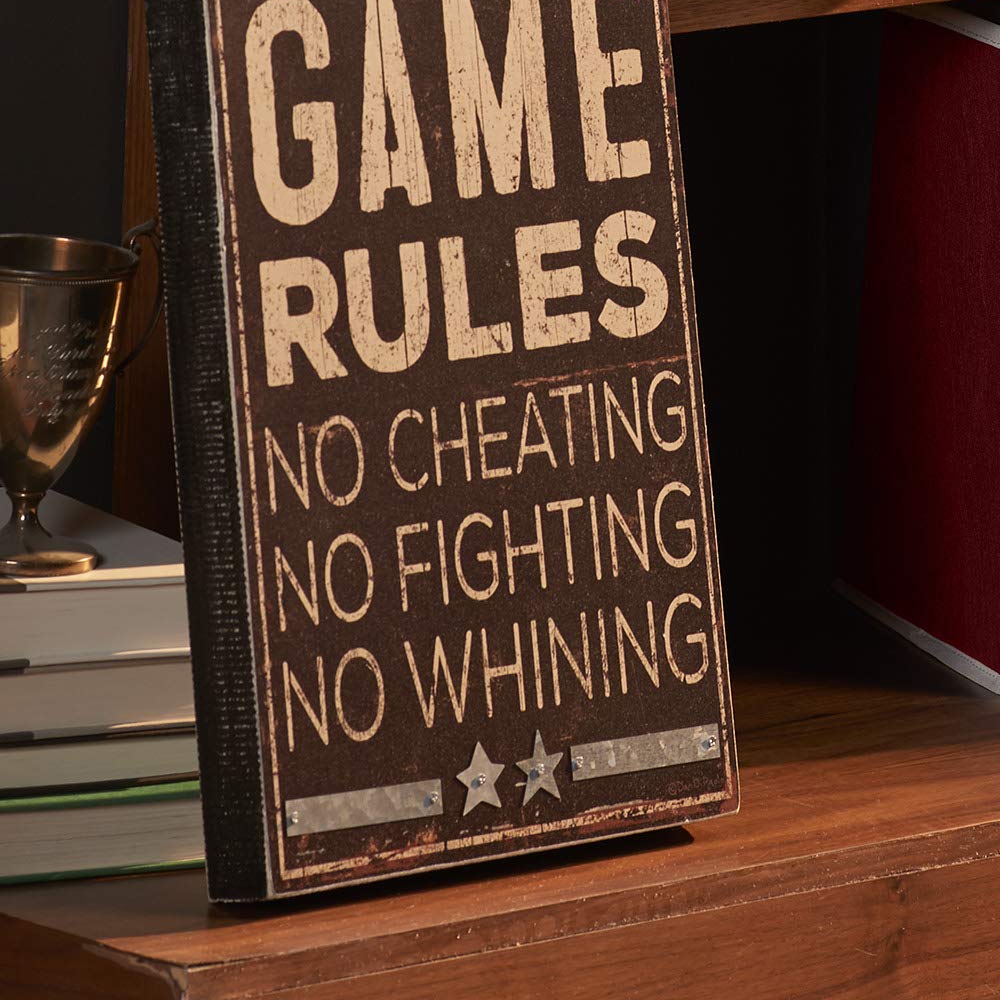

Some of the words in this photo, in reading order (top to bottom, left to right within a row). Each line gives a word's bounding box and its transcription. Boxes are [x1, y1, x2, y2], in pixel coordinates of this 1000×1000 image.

[259, 210, 669, 388] RULES
[265, 415, 364, 515] NO
[388, 370, 688, 491] CHEATING
[274, 533, 374, 632] NO
[396, 481, 698, 612] FIGHTING
[283, 648, 385, 752] NO
[404, 593, 709, 728] WHINING
